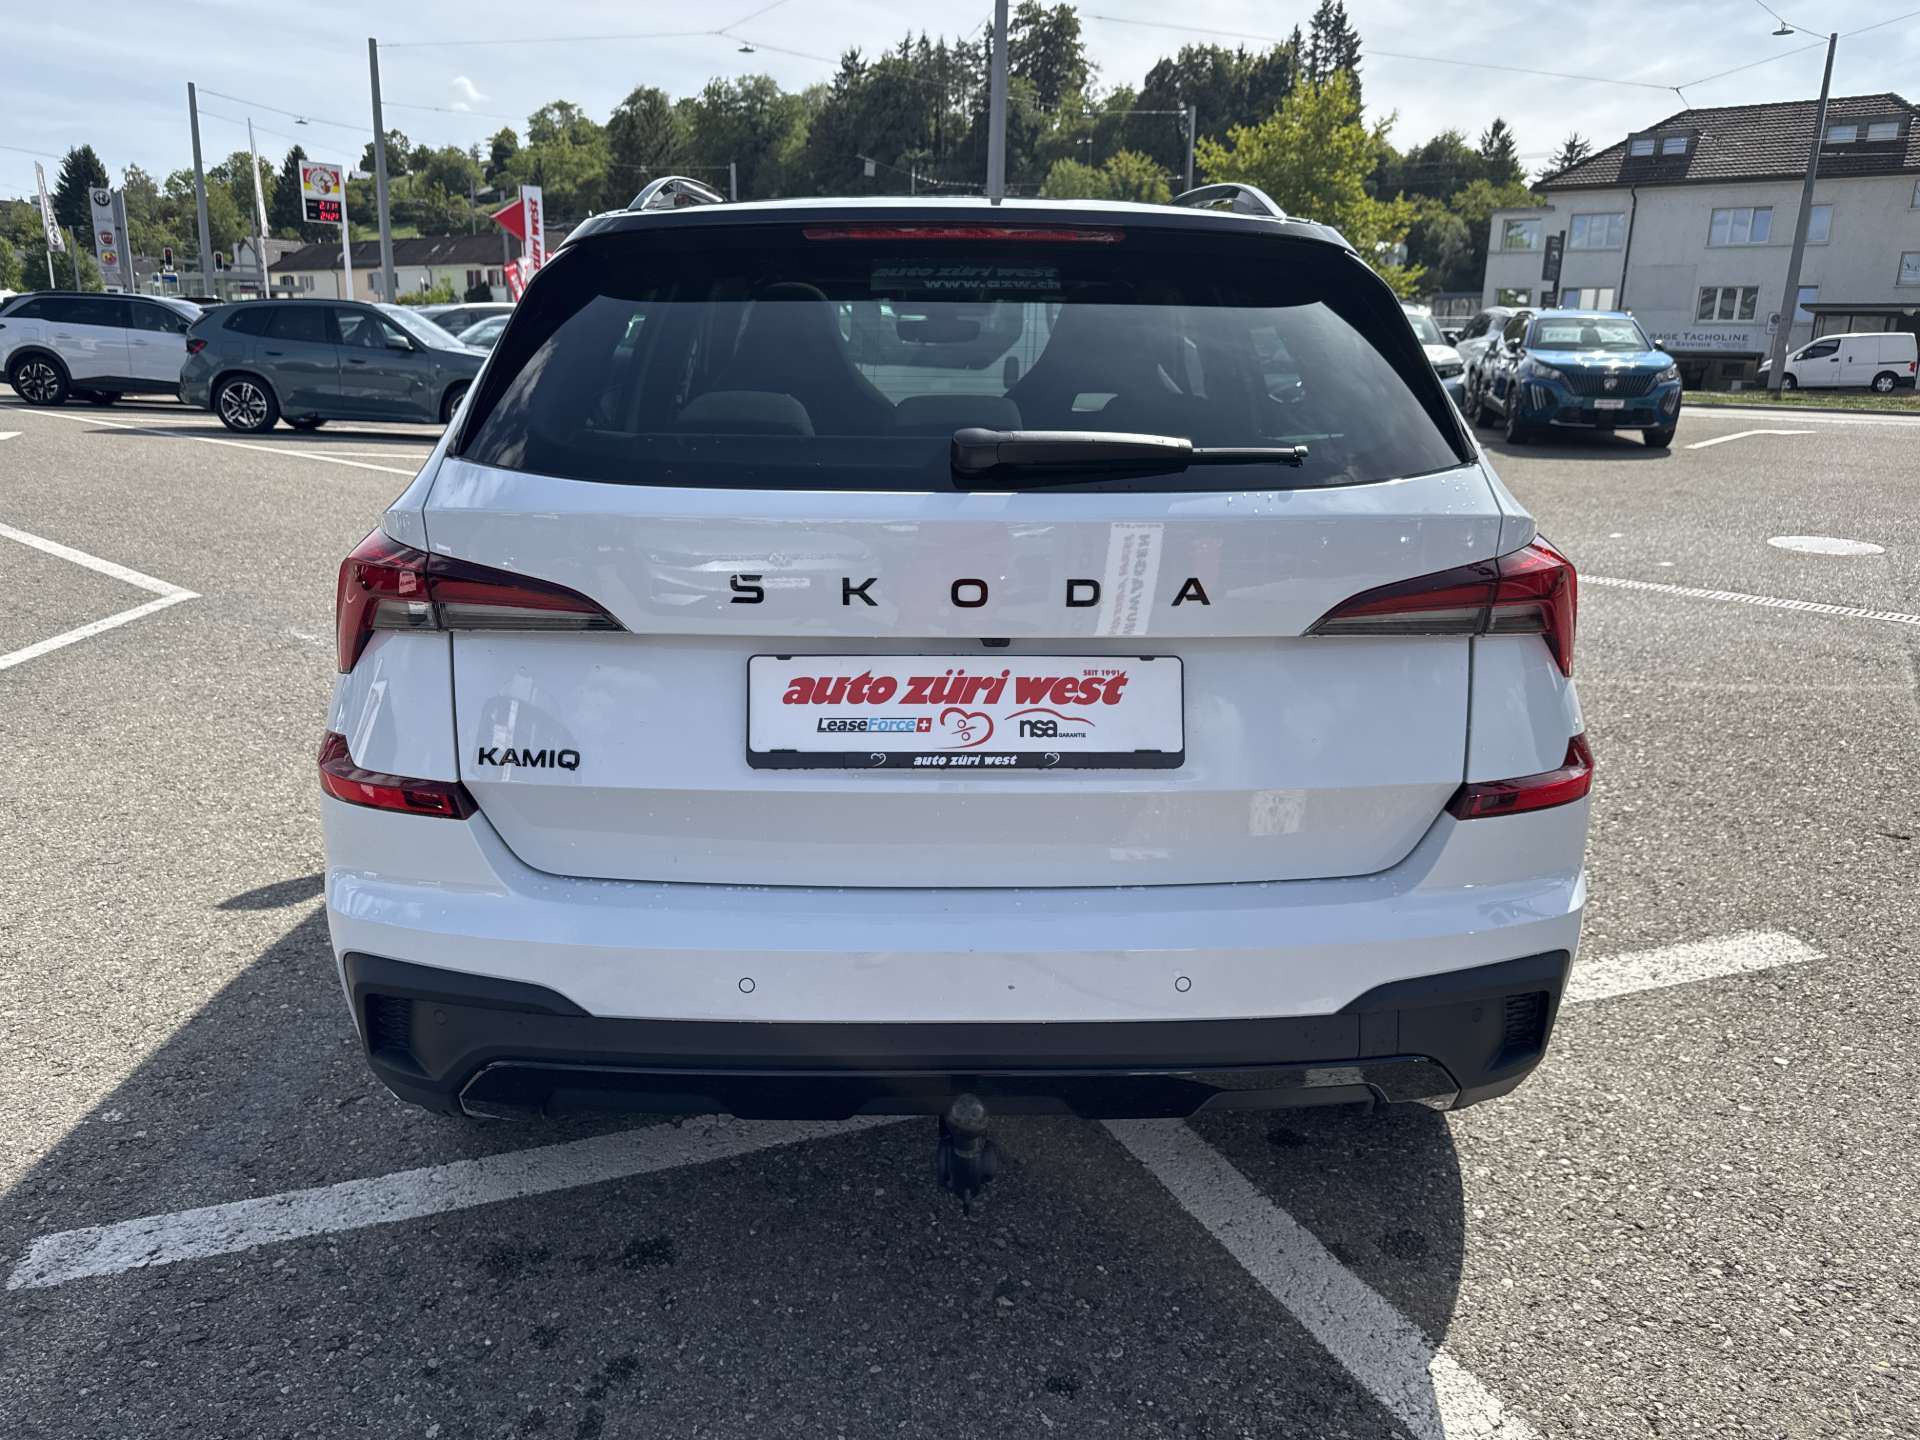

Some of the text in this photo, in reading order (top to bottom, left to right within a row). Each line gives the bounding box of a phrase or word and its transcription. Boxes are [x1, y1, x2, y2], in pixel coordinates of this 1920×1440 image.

[782, 669, 1129, 705] auto züri west
[817, 717, 915, 732] LeaseForce
[1019, 719, 1058, 738] nsa
[477, 747, 581, 772] KAMIQ
[913, 753, 1018, 766] auto züri west
